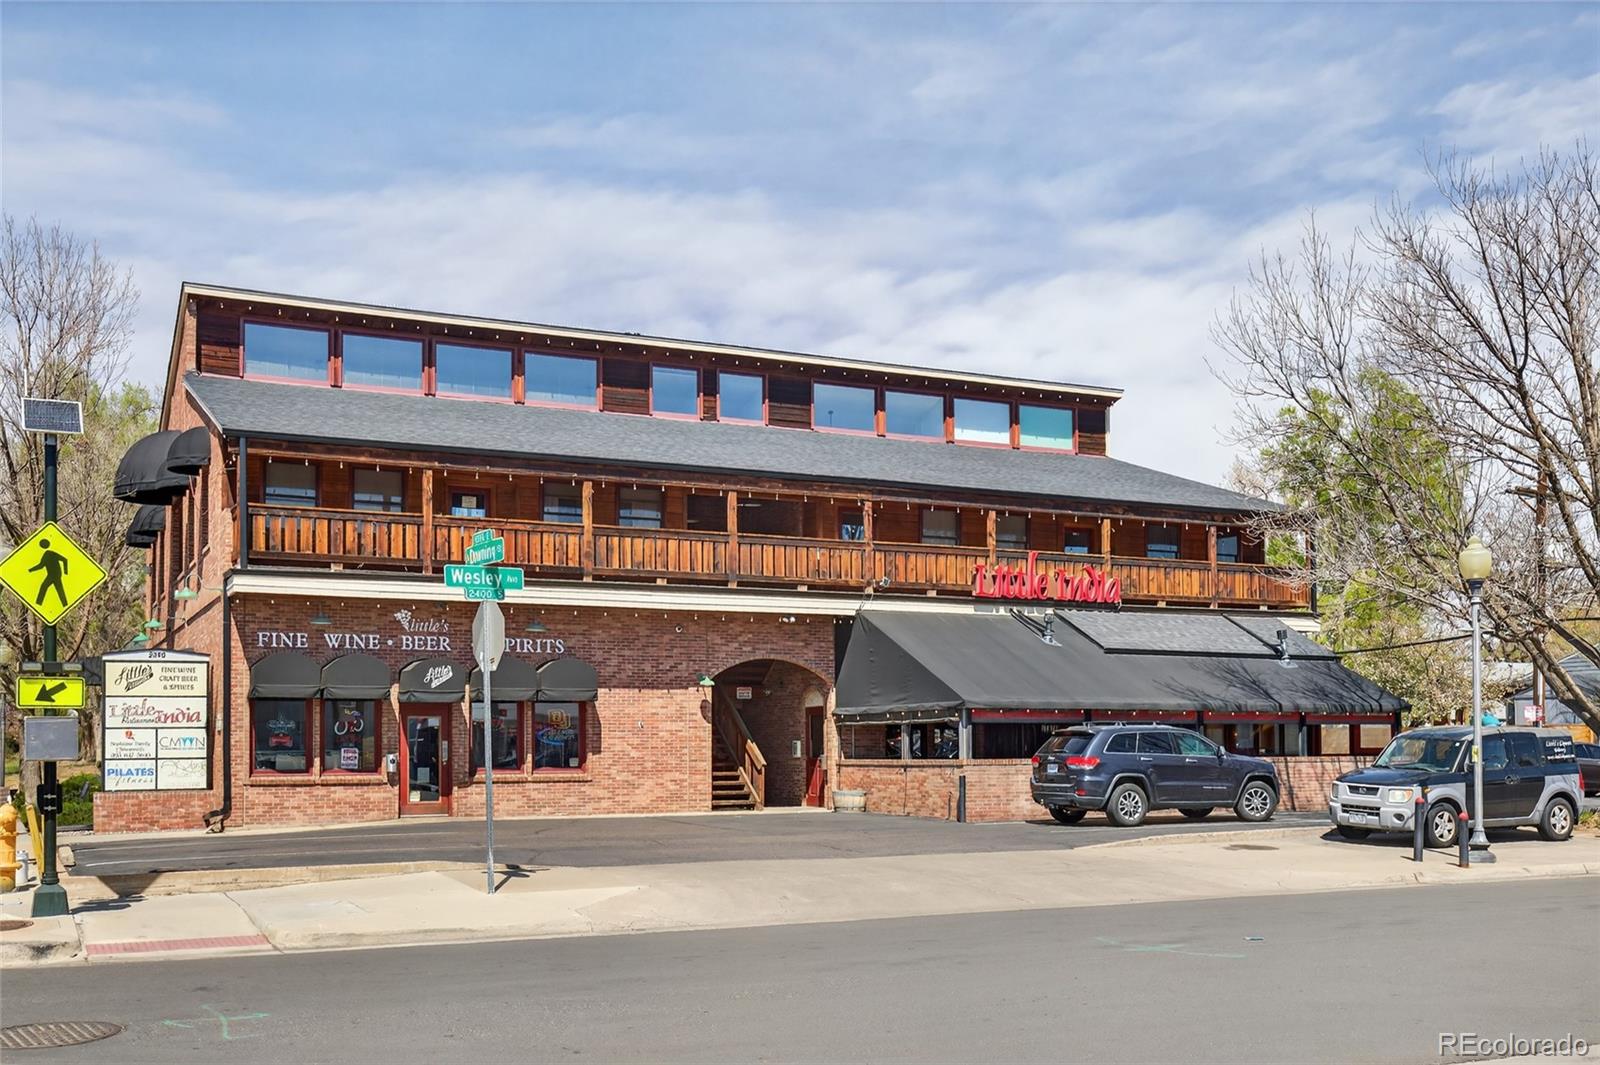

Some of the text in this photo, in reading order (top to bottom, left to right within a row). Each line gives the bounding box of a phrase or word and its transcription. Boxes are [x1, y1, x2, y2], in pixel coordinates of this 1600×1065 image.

[451, 568, 502, 588] Wesley
[972, 550, 1050, 600] Little
[468, 590, 504, 599] 2400 S
[257, 632, 565, 654] FINE WINE BEER PIRITS
[107, 768, 155, 777] PILATES
